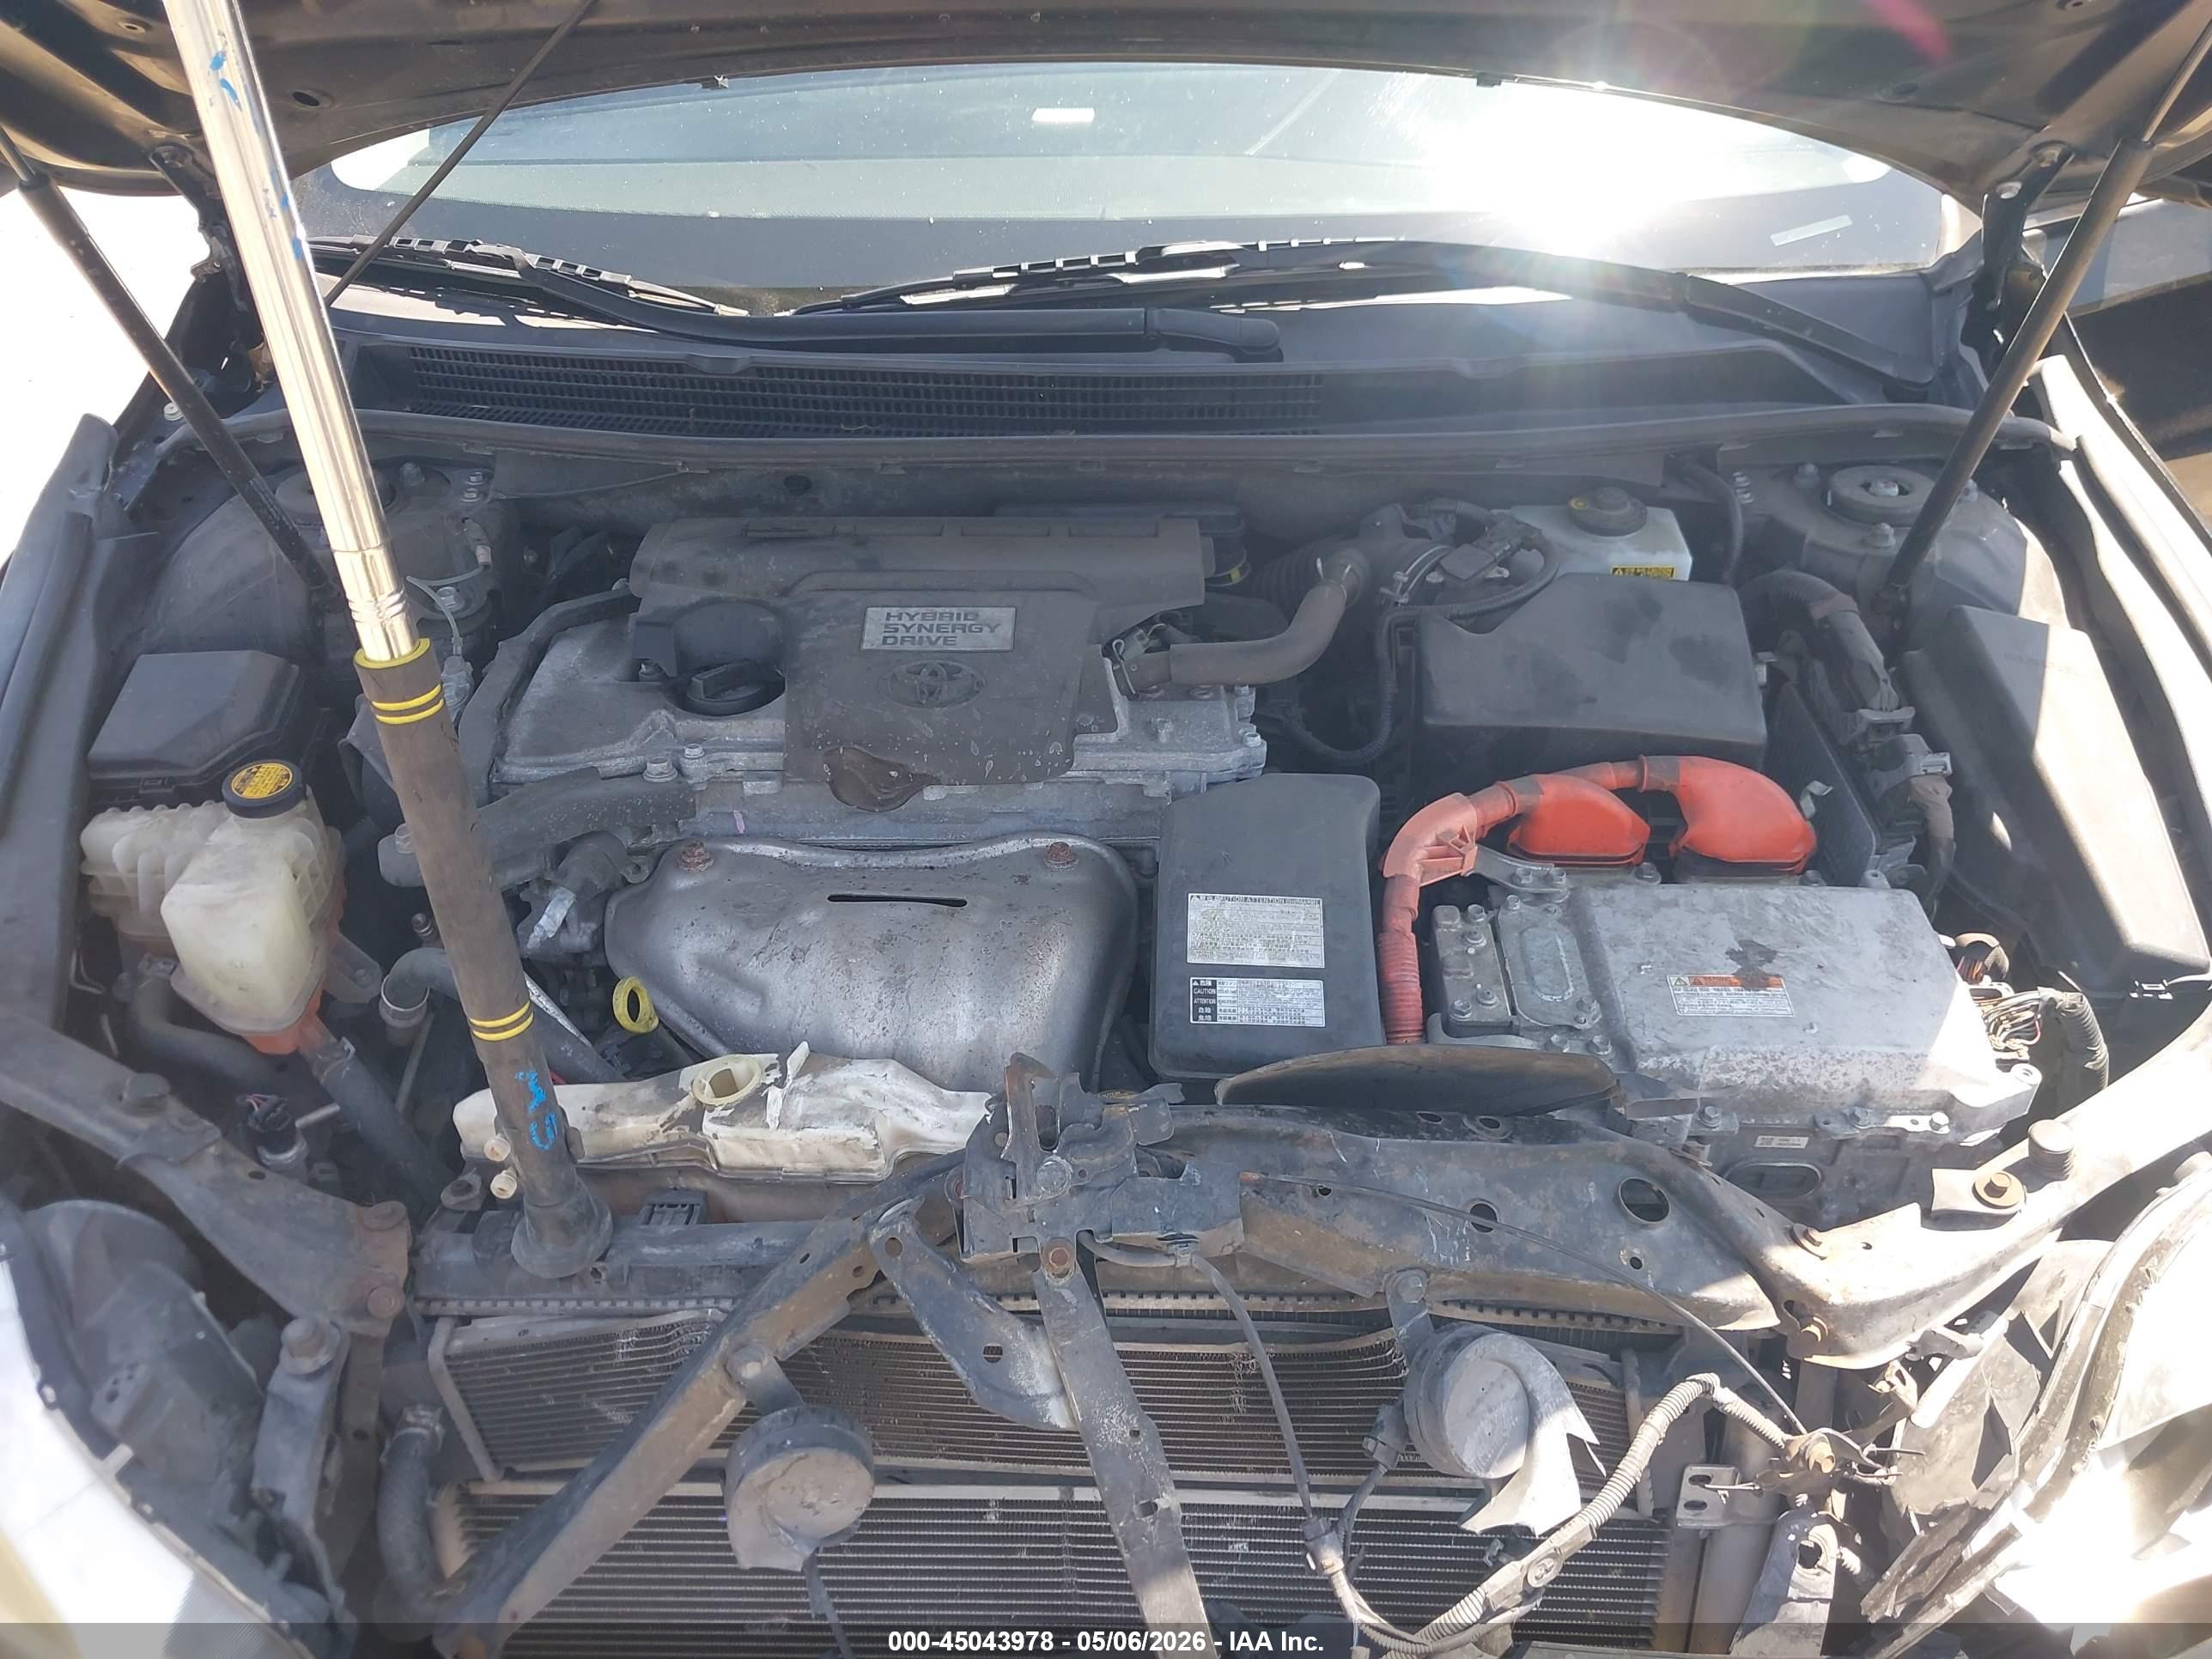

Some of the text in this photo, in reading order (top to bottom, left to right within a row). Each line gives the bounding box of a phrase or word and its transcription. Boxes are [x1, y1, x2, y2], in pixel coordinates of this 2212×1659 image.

[885, 611, 980, 622] HYBRID
[883, 623, 1002, 634] SYNERGY
[881, 635, 957, 646] DRIVE
